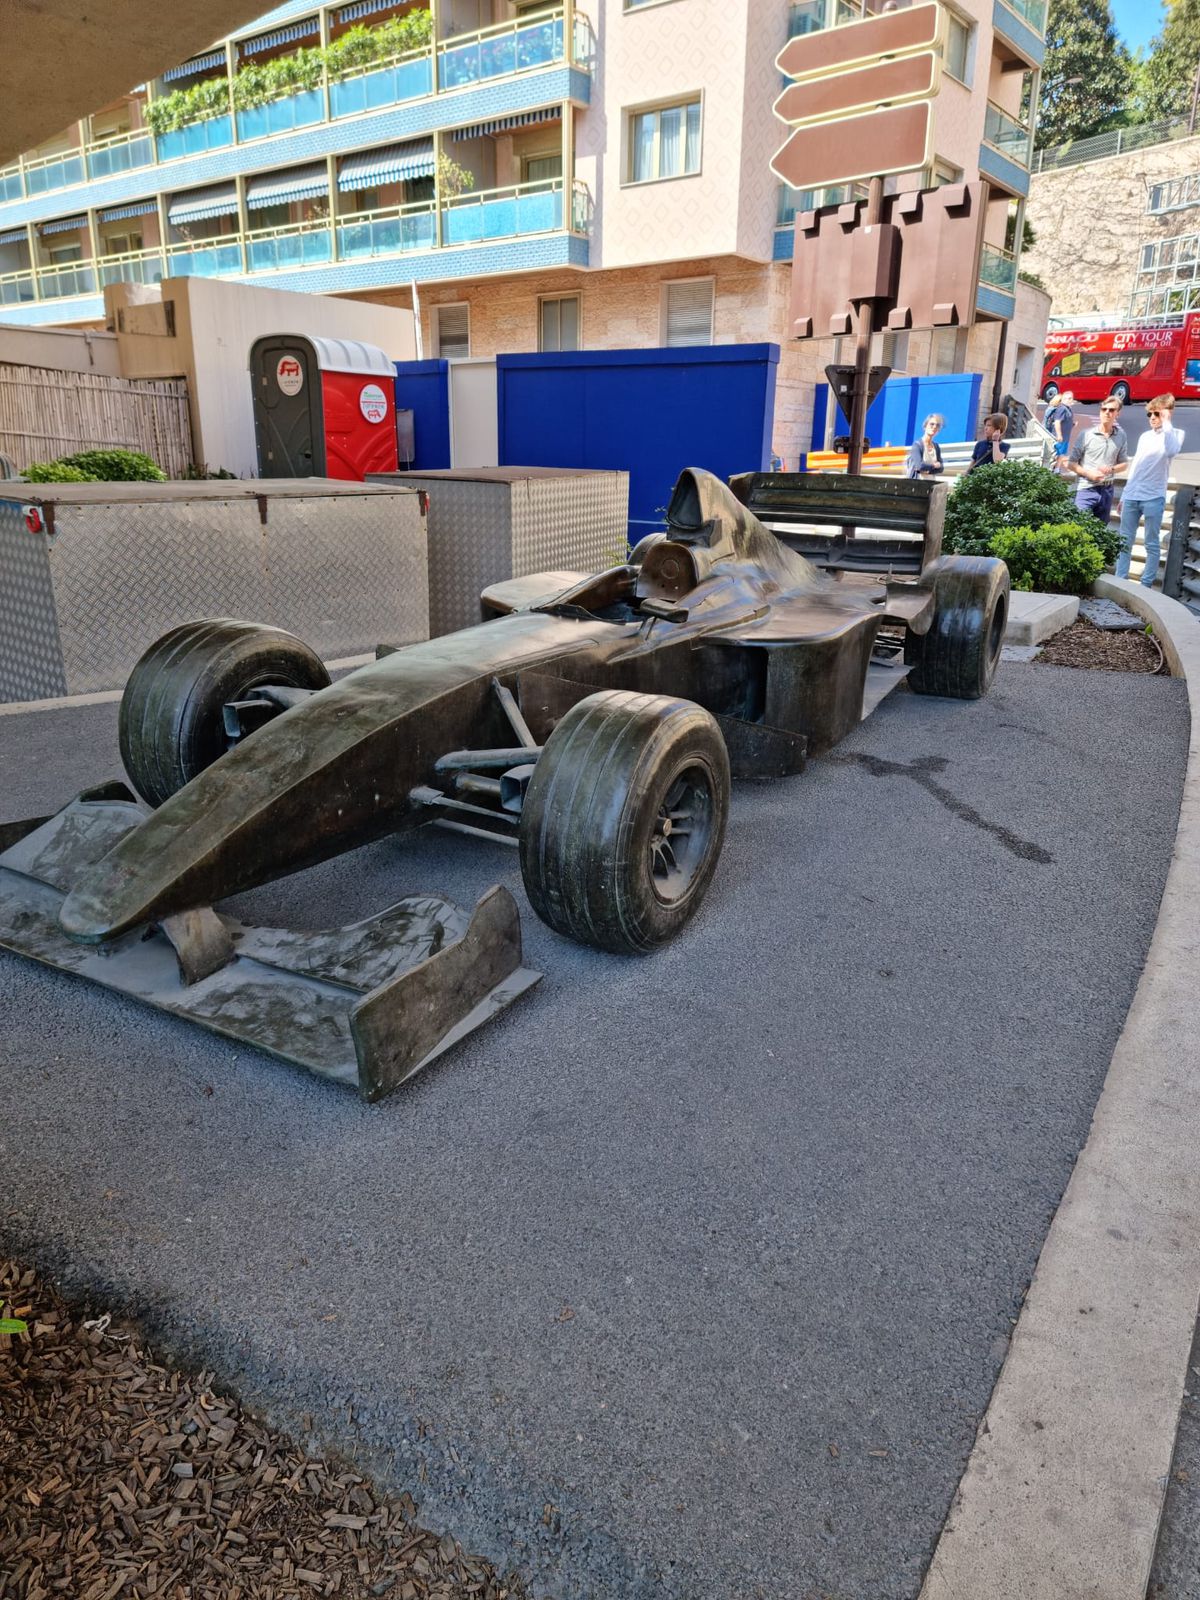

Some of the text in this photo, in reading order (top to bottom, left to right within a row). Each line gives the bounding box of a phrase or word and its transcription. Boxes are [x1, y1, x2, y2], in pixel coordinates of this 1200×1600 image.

[1045, 334, 1099, 344] ONACO
[1113, 331, 1173, 343] CITY TOUR
